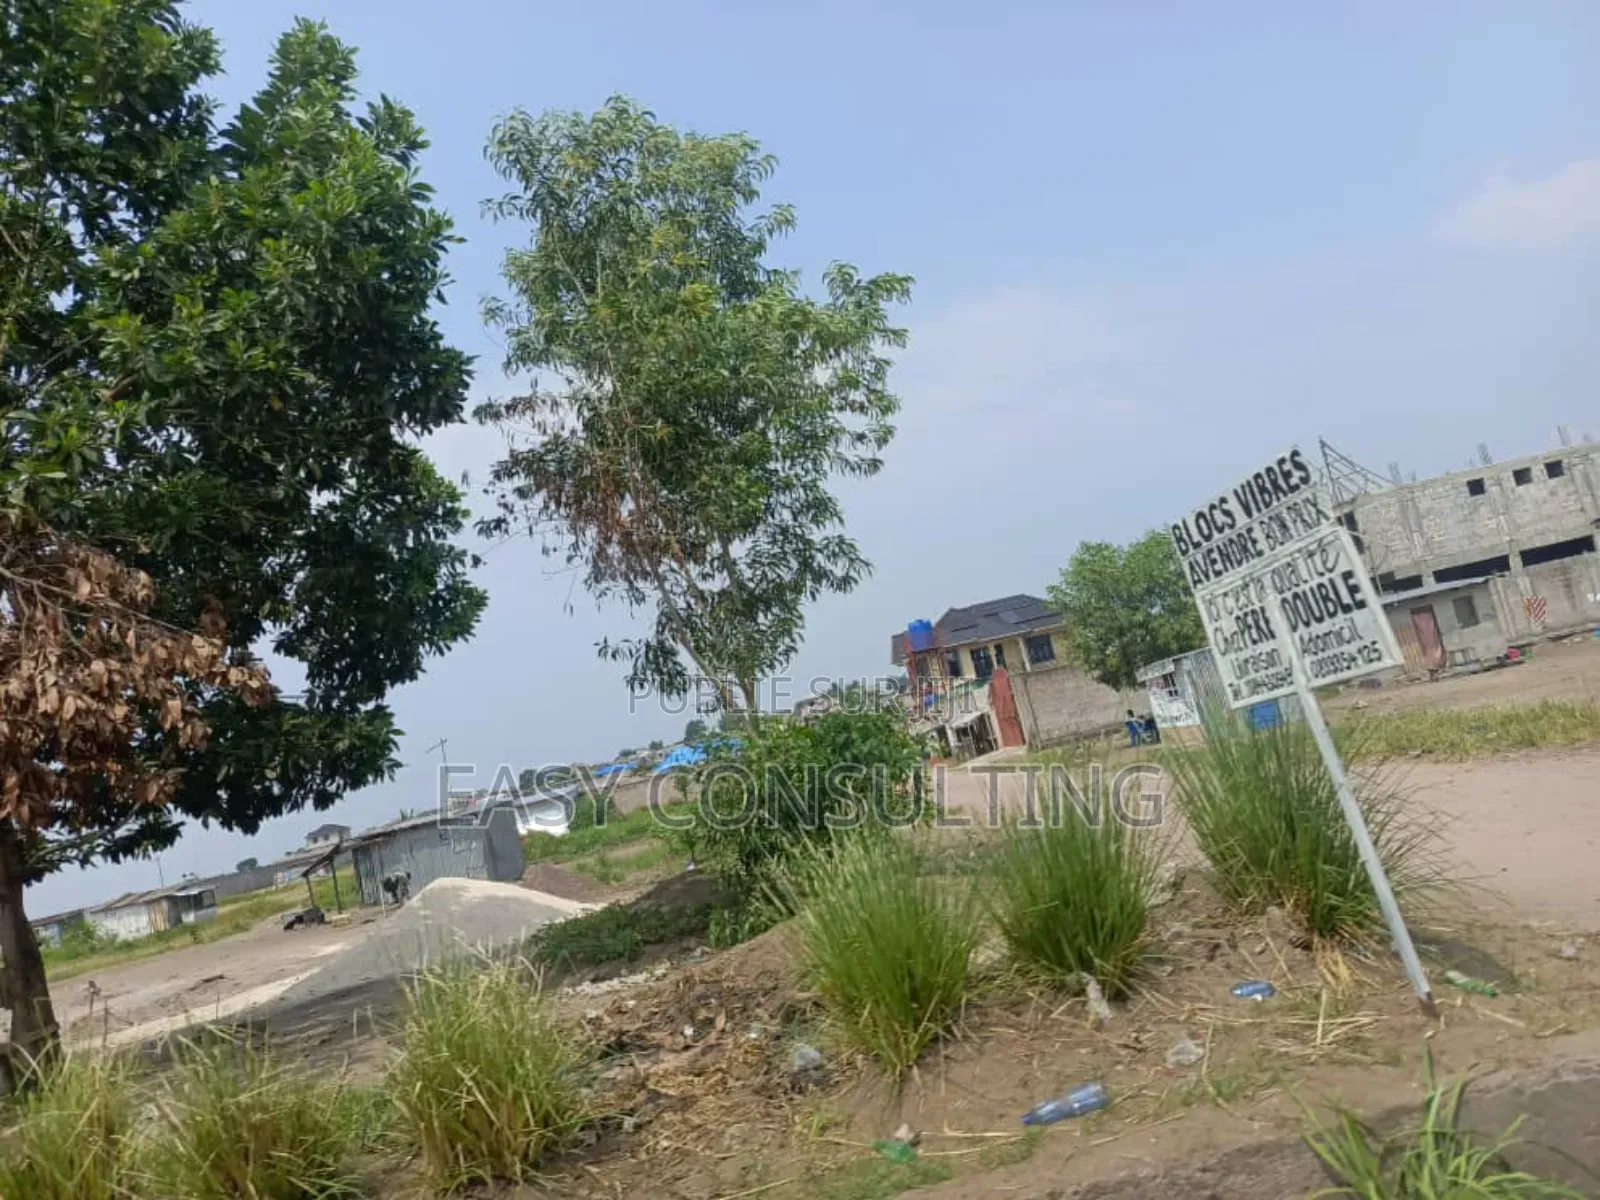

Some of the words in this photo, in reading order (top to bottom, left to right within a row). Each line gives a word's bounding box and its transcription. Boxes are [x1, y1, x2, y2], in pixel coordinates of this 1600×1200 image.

[1172, 497, 1236, 557] BLOCS
[1233, 449, 1311, 519] VIBRES
[1285, 492, 1330, 539] PRIX
[1280, 570, 1367, 633] DOUBLE
